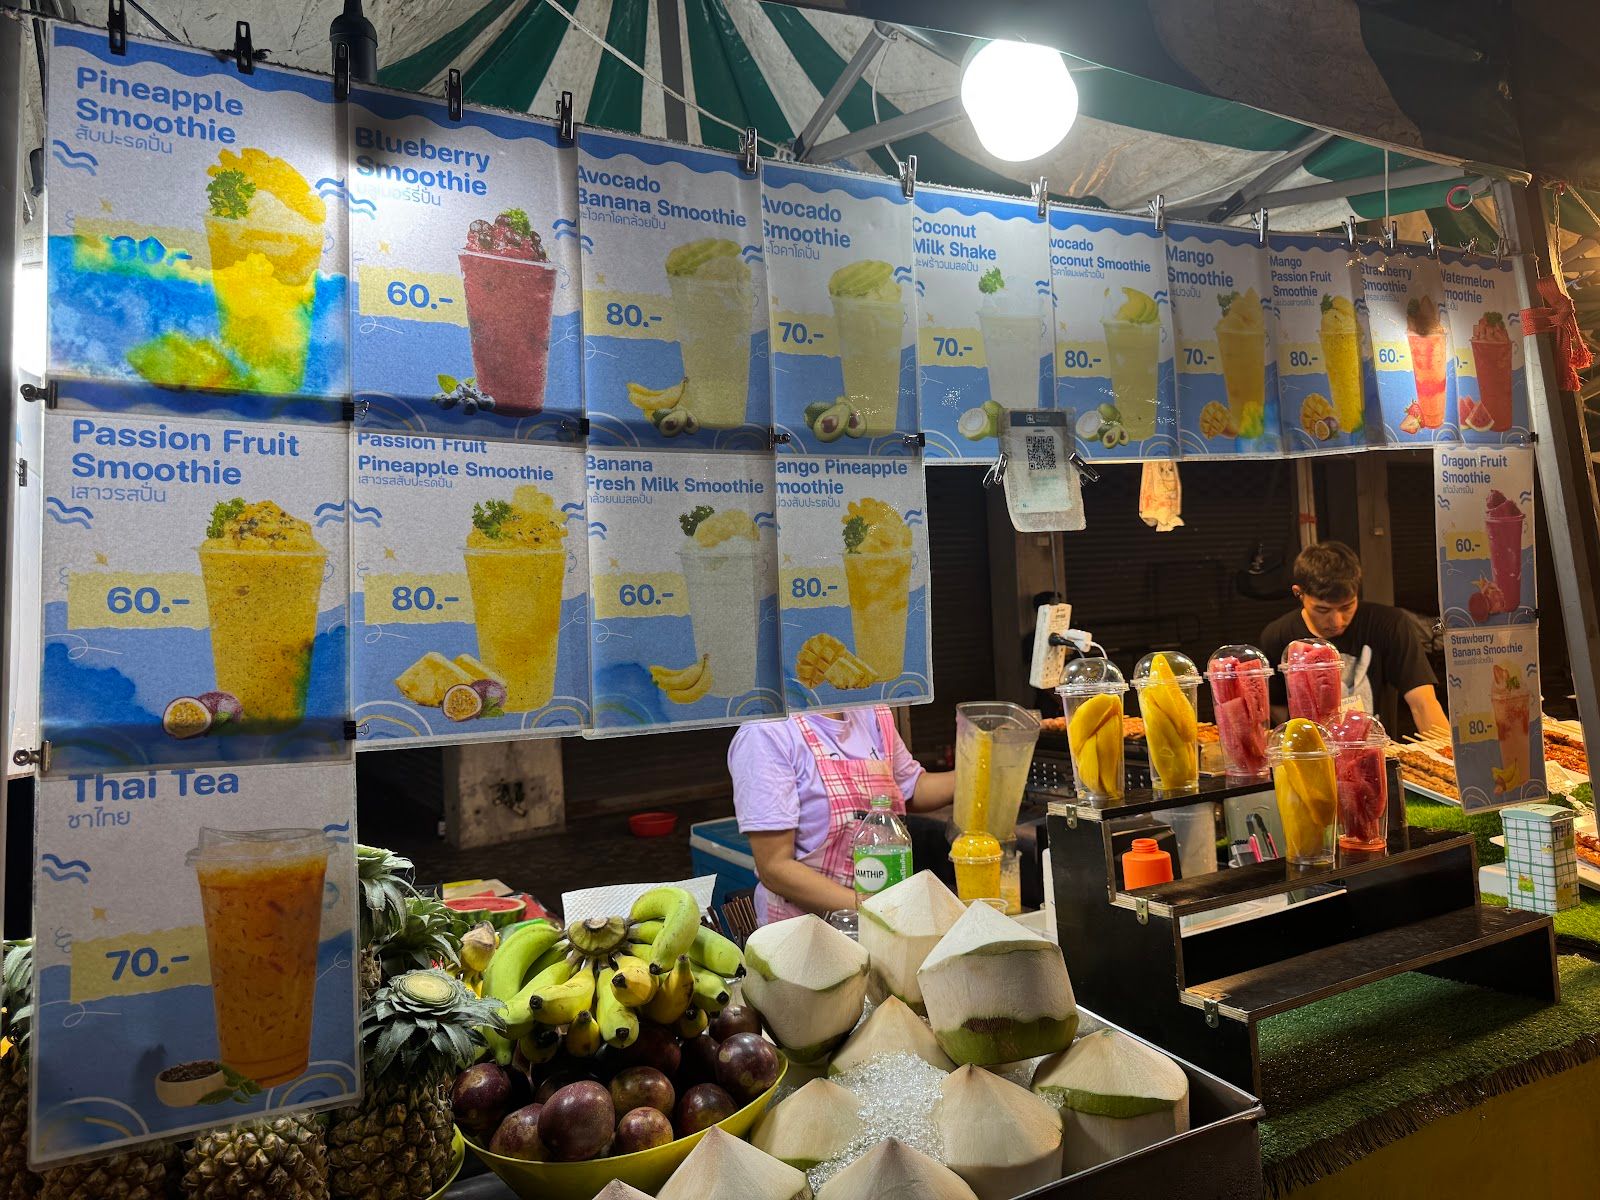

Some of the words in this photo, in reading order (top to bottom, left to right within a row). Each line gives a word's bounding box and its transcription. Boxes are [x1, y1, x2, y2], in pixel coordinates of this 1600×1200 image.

[76, 66, 244, 115] Pineapple
[76, 98, 236, 144] Smoothie
[355, 126, 490, 173] Blueberry
[356, 155, 488, 196] Smoothie
[577, 165, 661, 193] Avocado
[578, 188, 651, 214] Banana
[657, 199, 747, 228] Smoothie
[580, 207, 666, 230] ะโวคาโดกล้วยปั่น
[762, 219, 851, 248] Smoothie
[912, 216, 977, 239] Coconut
[912, 237, 945, 256] Milk
[949, 241, 997, 261] Shake
[1049, 238, 1094, 252] vocado
[1166, 244, 1214, 268] Mango
[1050, 254, 1094, 268] oconut
[1097, 256, 1151, 273] Smoothie
[1269, 255, 1302, 270] Mango
[1167, 266, 1234, 288] Smoothie
[1271, 270, 1308, 282] Passion
[1310, 271, 1332, 283] Fruit
[1361, 278, 1408, 293] Smoothie
[387, 281, 454, 310] 60.-
[1273, 285, 1318, 297] Smoothie
[1445, 289, 1482, 304] moothie
[606, 303, 662, 328] 80.-
[778, 321, 824, 345] 70.-
[933, 336, 973, 357] 70.-
[1183, 348, 1215, 365] 70.-
[1379, 348, 1405, 363] 60.-
[1064, 350, 1101, 368] 80.-
[1290, 351, 1318, 367] 80.-
[72, 419, 211, 452] Passion
[223, 429, 300, 457] Fruit
[357, 432, 436, 450] Passion
[442, 438, 488, 454] Fruit
[72, 452, 242, 486] Smoothie
[358, 455, 459, 478] Pineapple
[465, 461, 554, 481] Smoothie
[586, 455, 653, 472] Banana
[776, 461, 820, 477] ango
[825, 459, 908, 478] Pineapple
[1441, 454, 1477, 470] Dragon
[1480, 454, 1508, 468] Fruit
[587, 475, 636, 492] Fresh
[641, 477, 680, 492] Milk
[684, 477, 764, 494] Smoothie
[776, 479, 844, 495] moothie
[1442, 470, 1491, 484] Smoothie
[71, 481, 167, 503] เสาวรสปั่น
[1455, 538, 1481, 552] 60.-
[392, 586, 459, 611] 80.-
[619, 584, 674, 606] 60.-
[792, 577, 838, 598] 80.-
[107, 586, 190, 614] 60.-
[1451, 633, 1494, 645] Strawberry
[1452, 646, 1482, 658] Banana
[1483, 642, 1523, 656] Smoothie
[1469, 719, 1493, 735] 80.-
[68, 769, 157, 803] Thai
[171, 768, 239, 797] Tea
[68, 806, 131, 829] ชาไทย
[105, 947, 190, 981] 70.-
